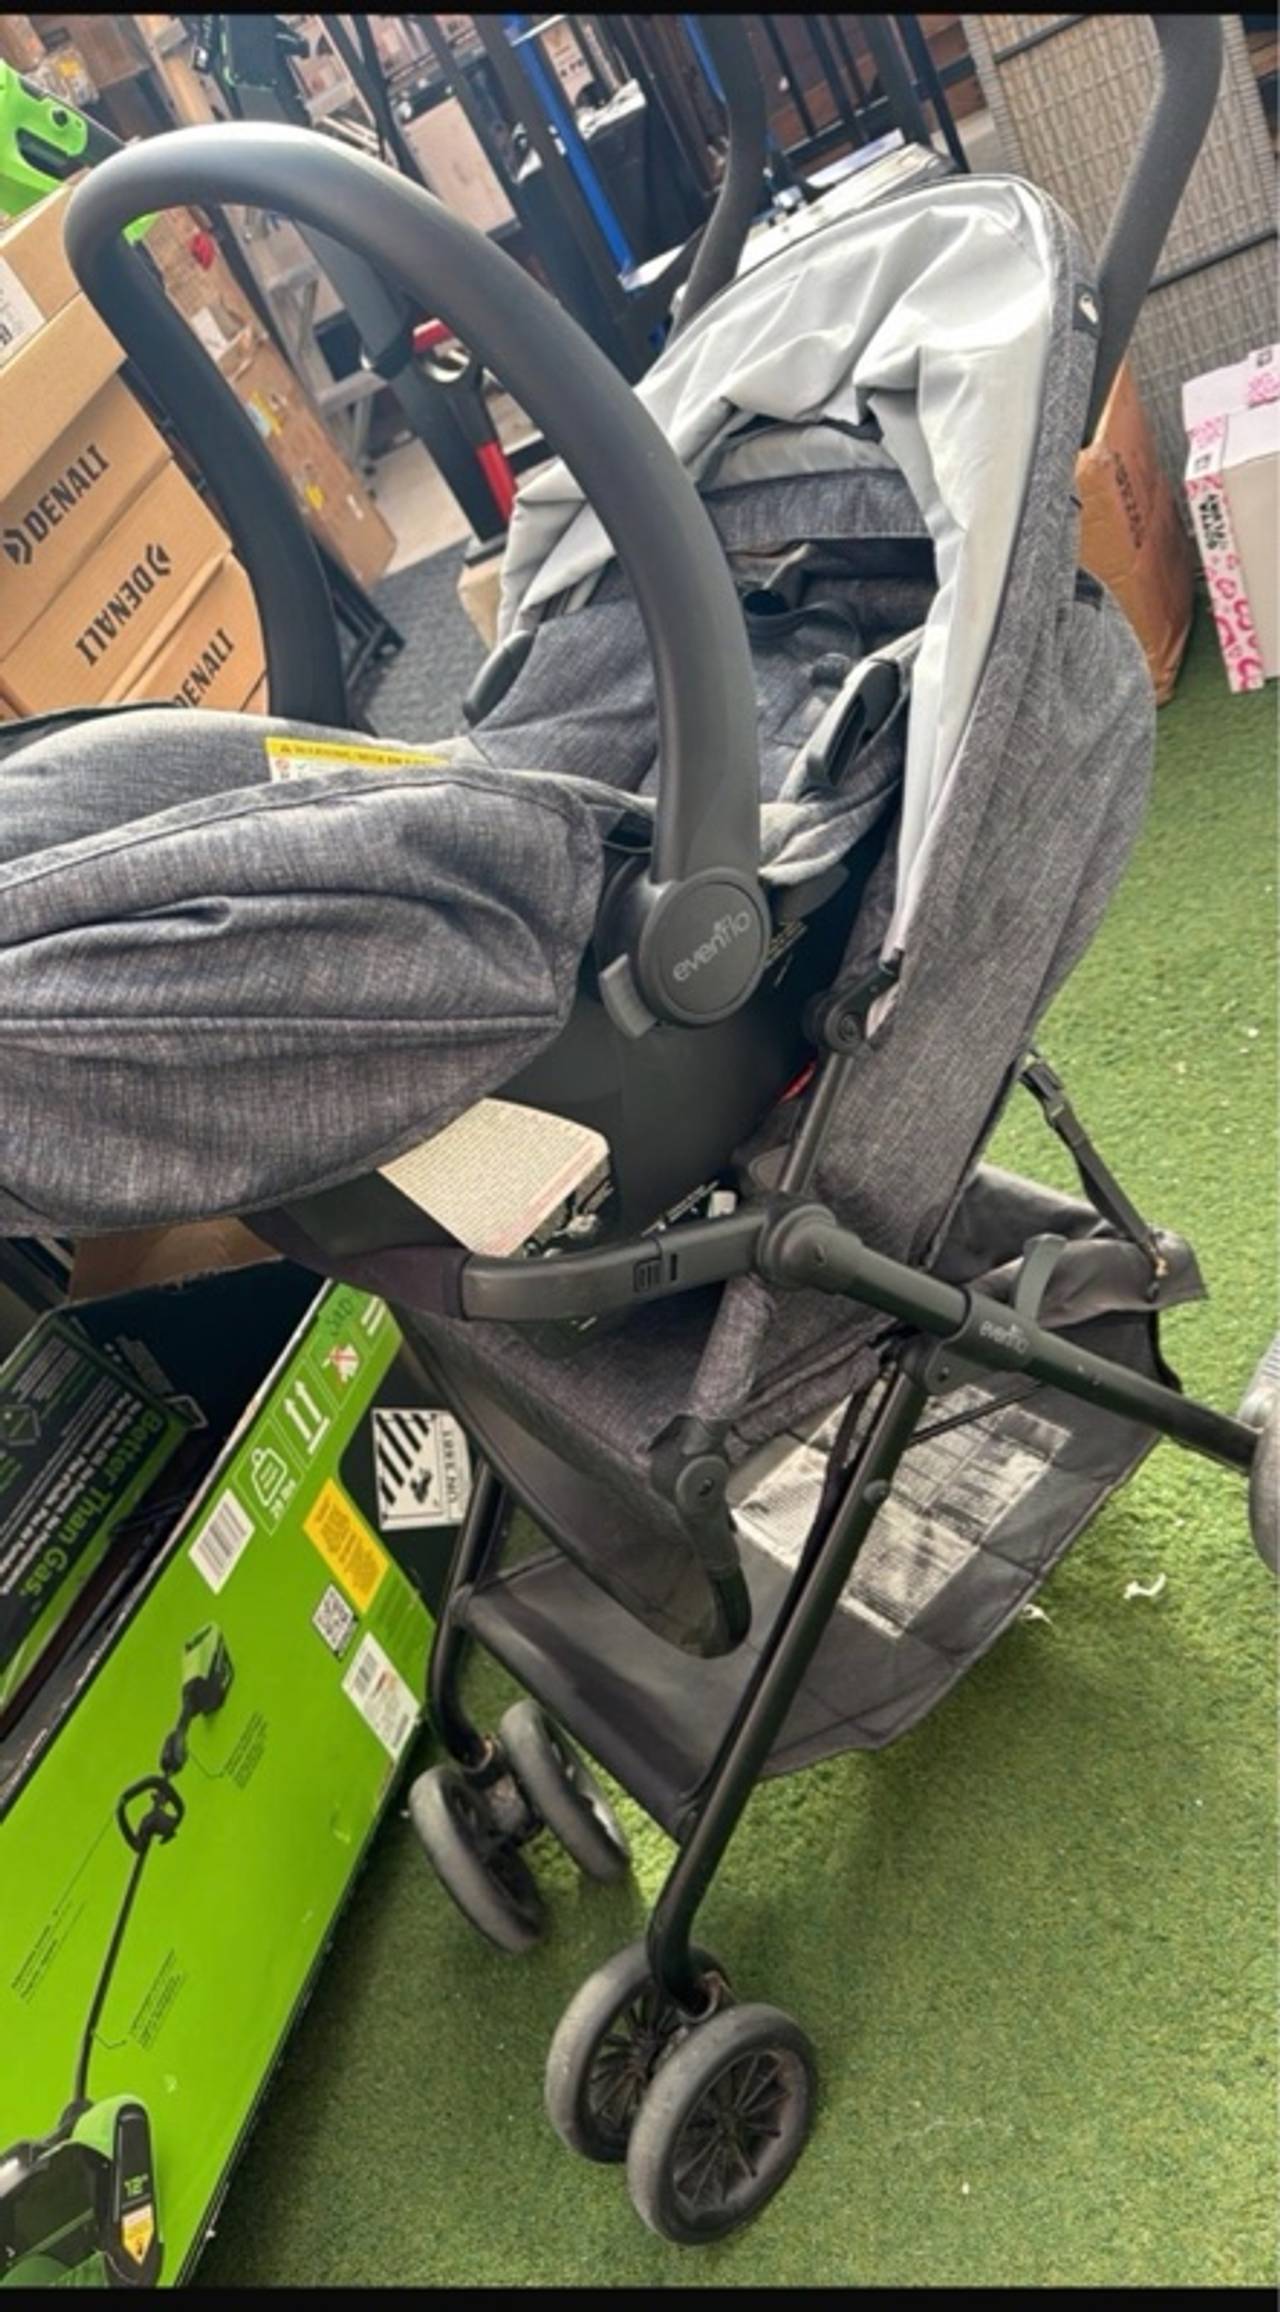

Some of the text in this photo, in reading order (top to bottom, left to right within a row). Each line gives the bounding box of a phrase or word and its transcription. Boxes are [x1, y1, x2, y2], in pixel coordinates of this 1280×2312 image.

[23, 443, 110, 544] DENALI
[75, 562, 156, 668] DENALI
[673, 911, 749, 982] evenflo
[980, 1321, 1030, 1355] evenflo
[104, 1409, 163, 1486] Better
[58, 1486, 114, 1544] Than
